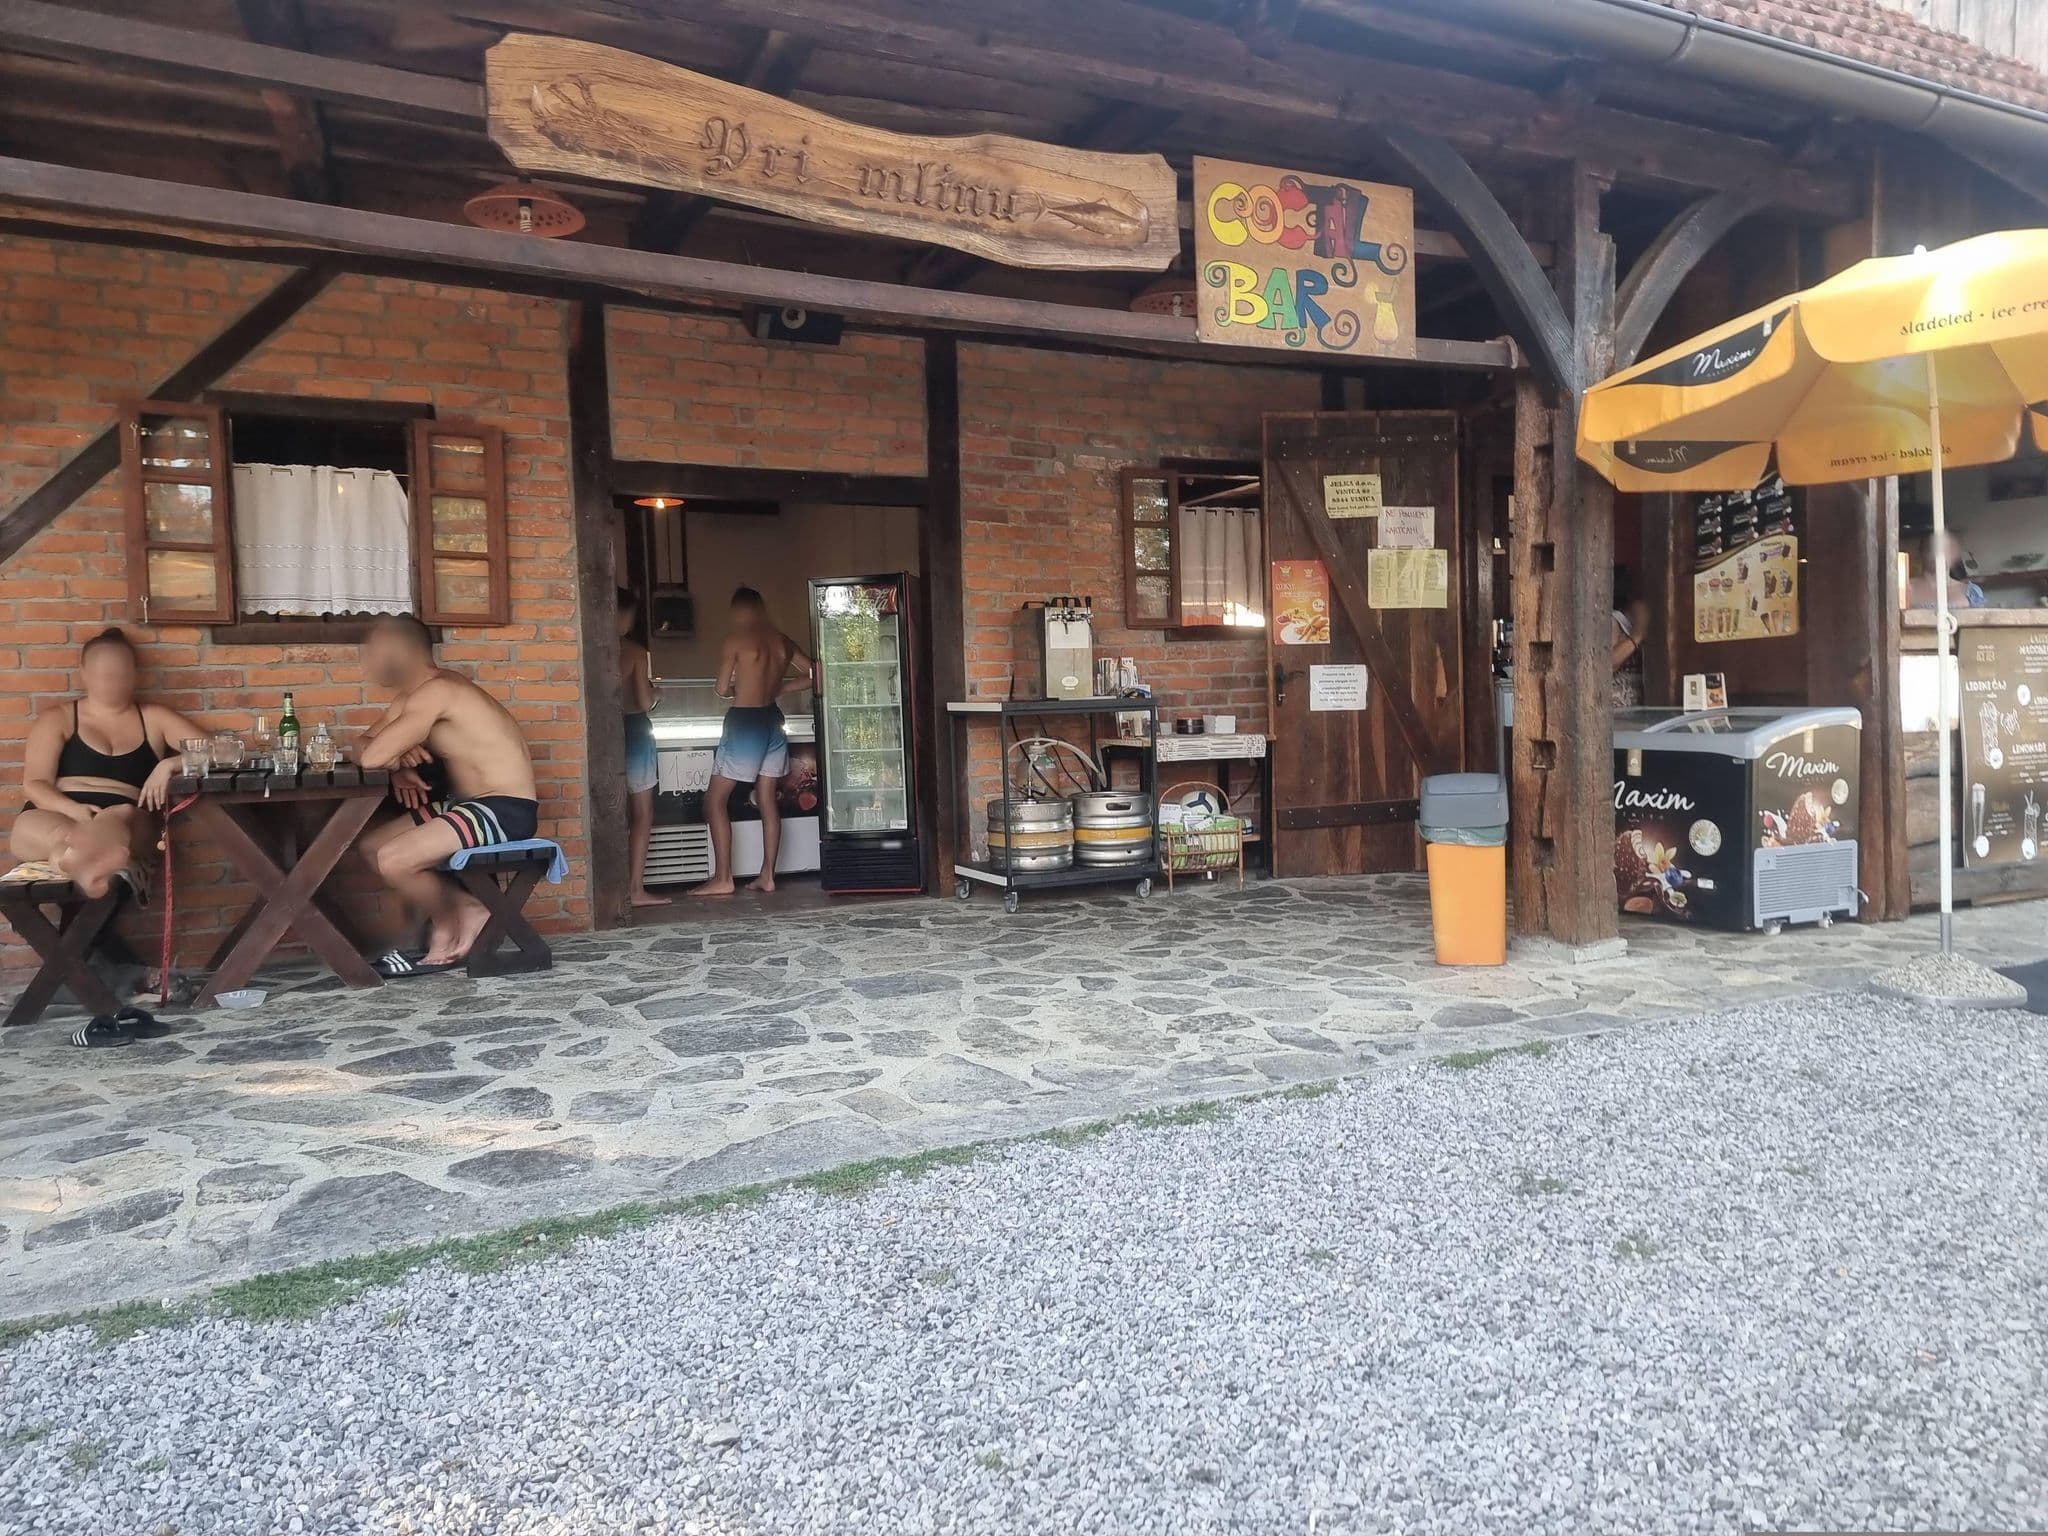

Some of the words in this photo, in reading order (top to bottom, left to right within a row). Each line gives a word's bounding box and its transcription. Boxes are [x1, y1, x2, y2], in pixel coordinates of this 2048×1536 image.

[700, 115, 811, 184] Pri
[858, 161, 1020, 222] mlinu
[1204, 260, 1360, 350] BAR
[1899, 310, 1974, 336] sladoled
[1991, 306, 2017, 320] ice
[1692, 347, 1757, 377] Maxim
[1766, 751, 1840, 778] Maxim
